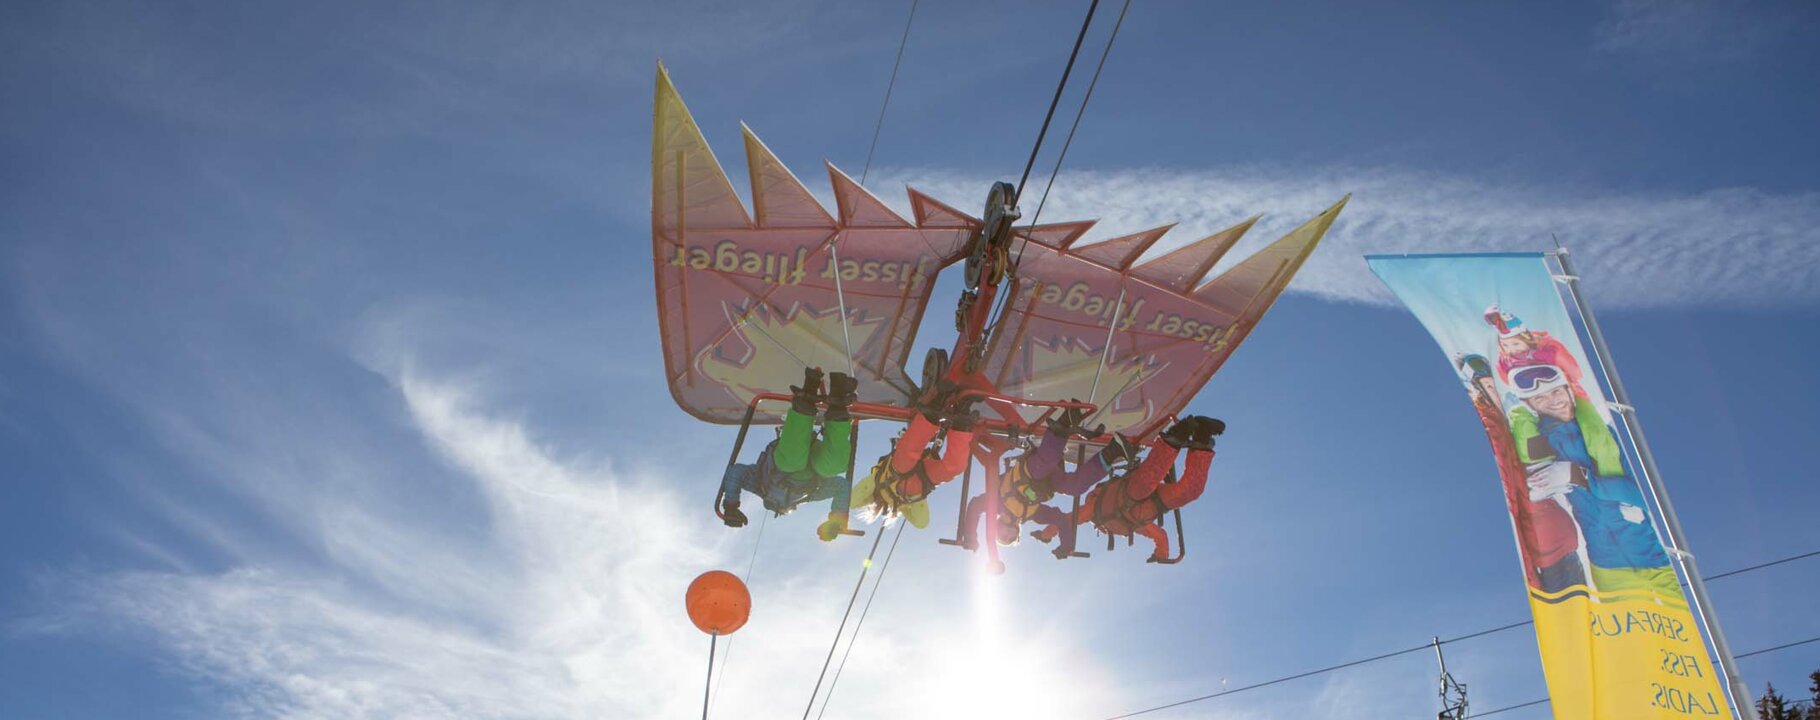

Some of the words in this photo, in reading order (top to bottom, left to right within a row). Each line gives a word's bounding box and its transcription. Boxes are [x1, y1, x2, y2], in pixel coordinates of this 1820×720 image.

[670, 242, 808, 286] flieger
[821, 254, 928, 290] fisser
[1146, 311, 1239, 352] fisser
